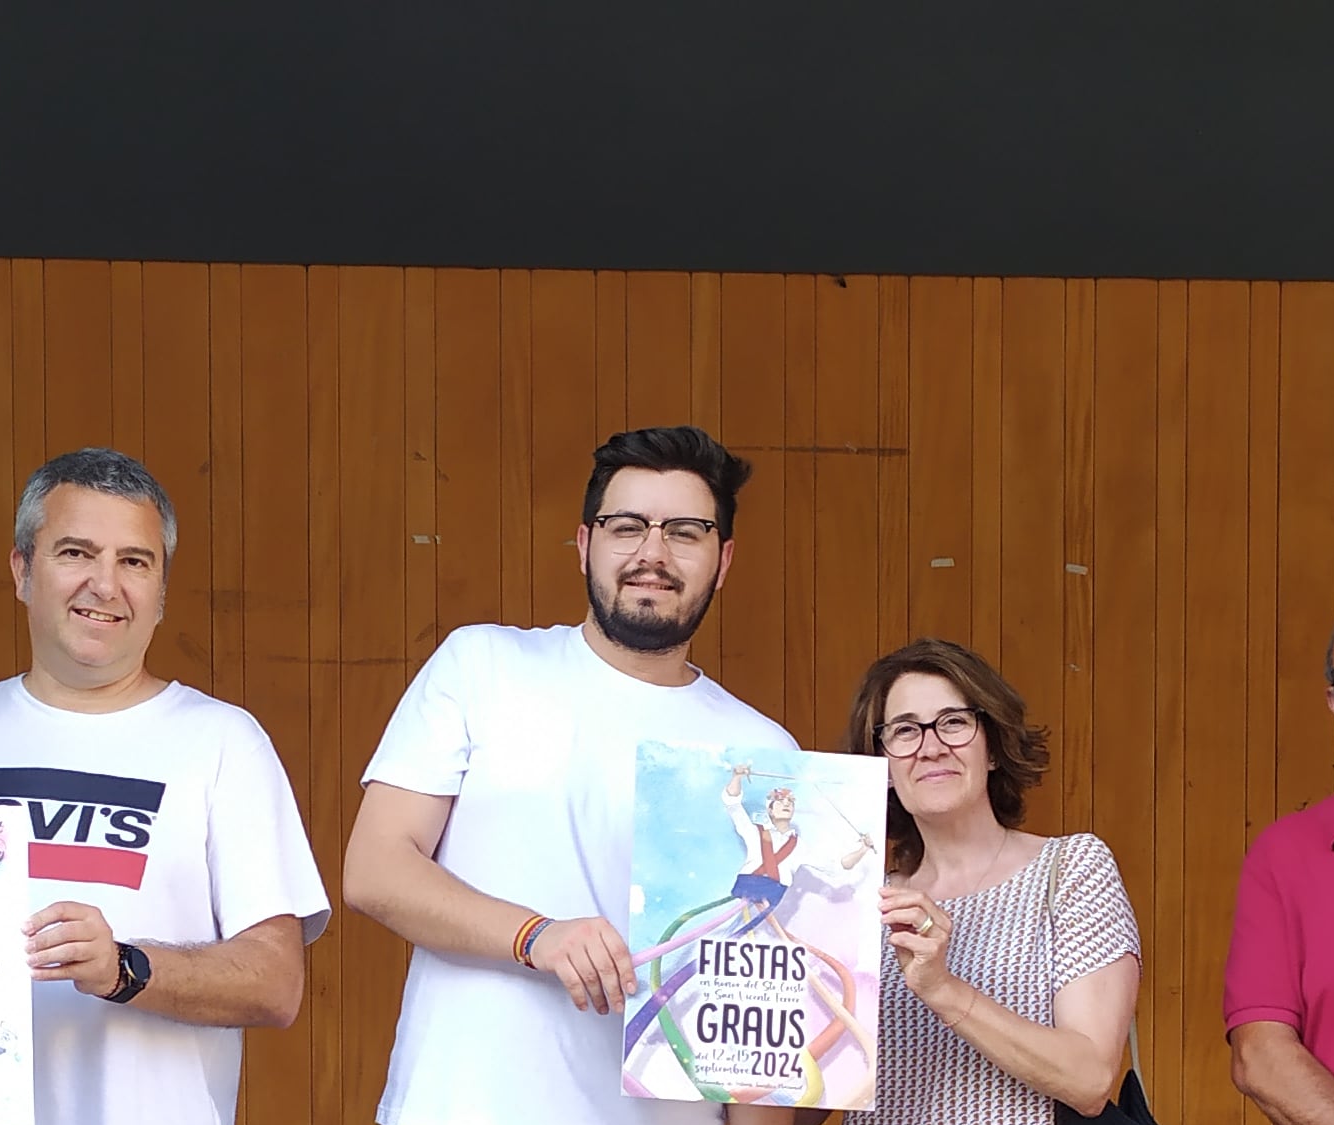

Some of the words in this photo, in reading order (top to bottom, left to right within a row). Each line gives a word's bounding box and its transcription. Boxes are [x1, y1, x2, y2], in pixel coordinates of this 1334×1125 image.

[699, 939, 807, 982] FIESTAS
[700, 980, 710, 988] en
[714, 977, 740, 988] honor
[744, 980, 758, 988] del
[703, 992, 710, 1001] y
[714, 989, 734, 1000] San
[696, 1002, 805, 1049] GRAUS
[694, 1062, 750, 1076] septiembre
[750, 1050, 803, 1079] 2024
[695, 1052, 708, 1060] del
[712, 1049, 724, 1061] 12
[737, 1049, 750, 1062] 15
